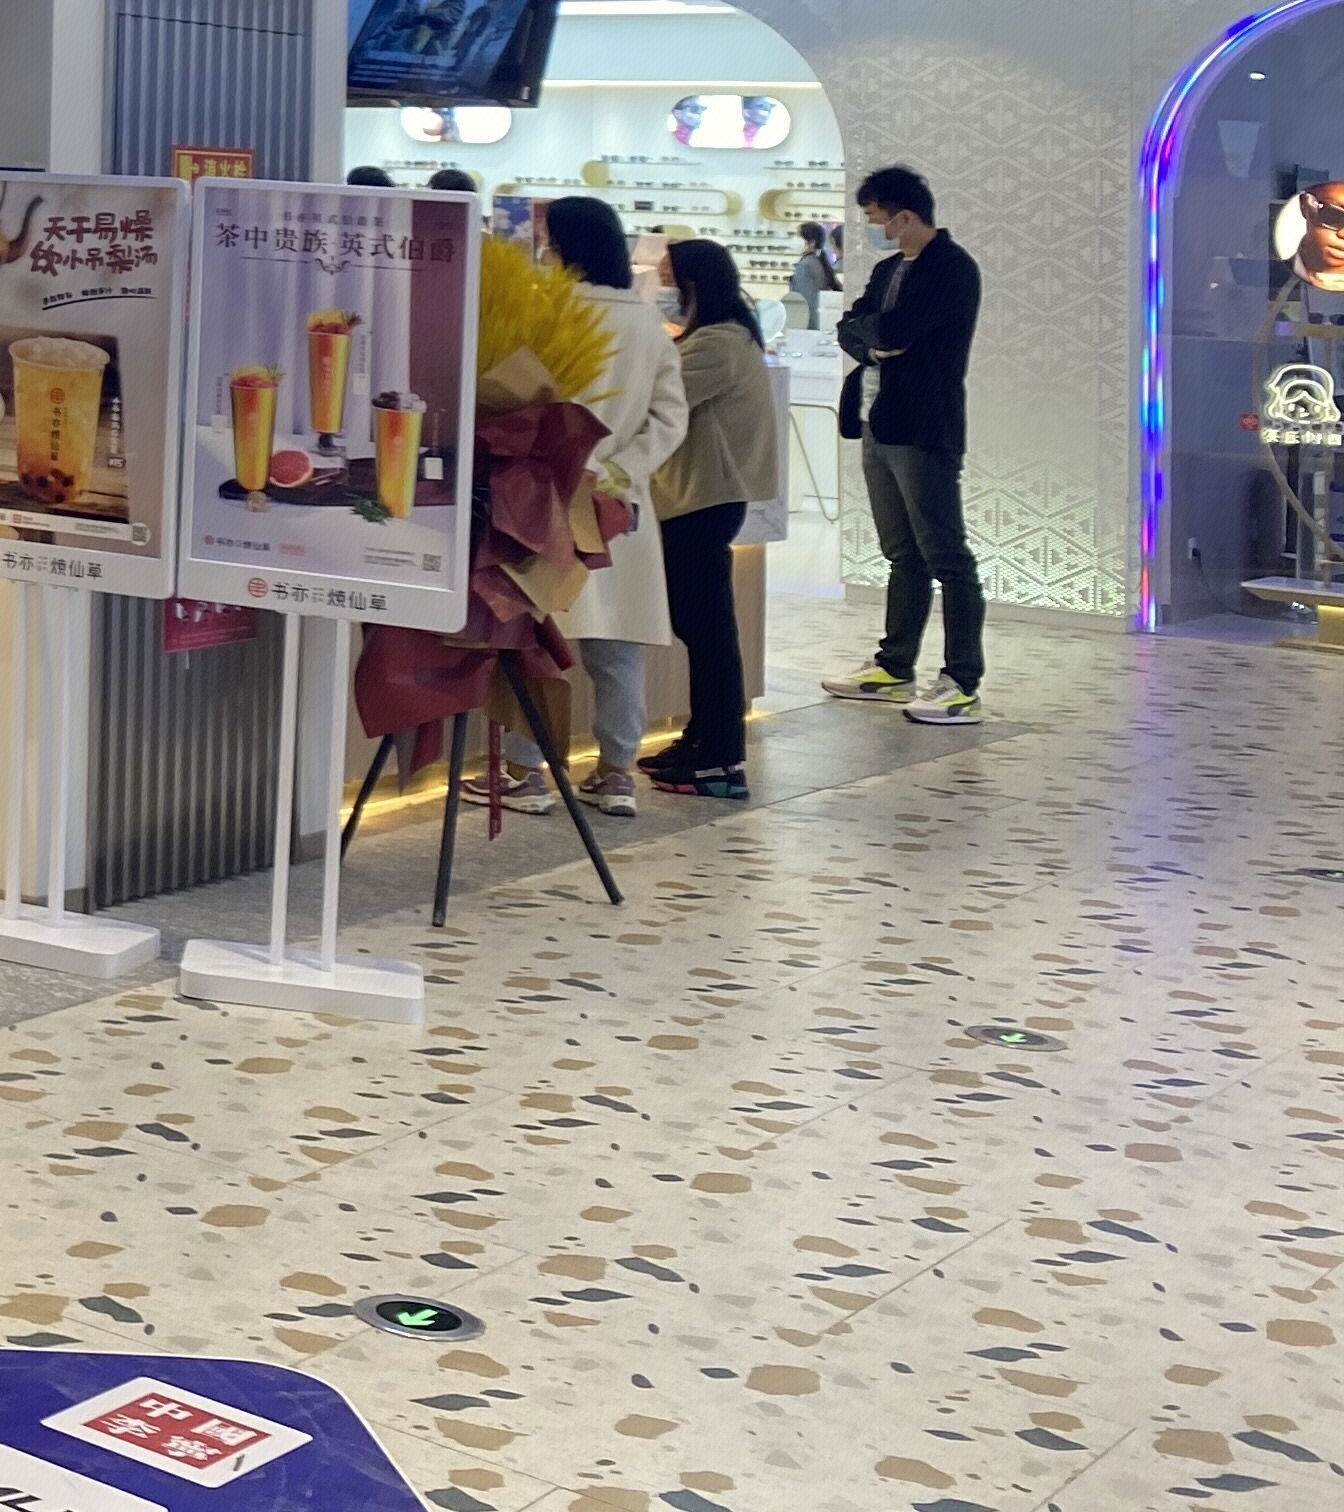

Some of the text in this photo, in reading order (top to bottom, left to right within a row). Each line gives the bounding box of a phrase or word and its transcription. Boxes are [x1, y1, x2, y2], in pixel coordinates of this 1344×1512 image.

[43, 209, 155, 244] 天干易燥
[215, 223, 456, 263] 茶中贵族 英式伯爵
[29, 240, 159, 277] 饮小吊梨汤
